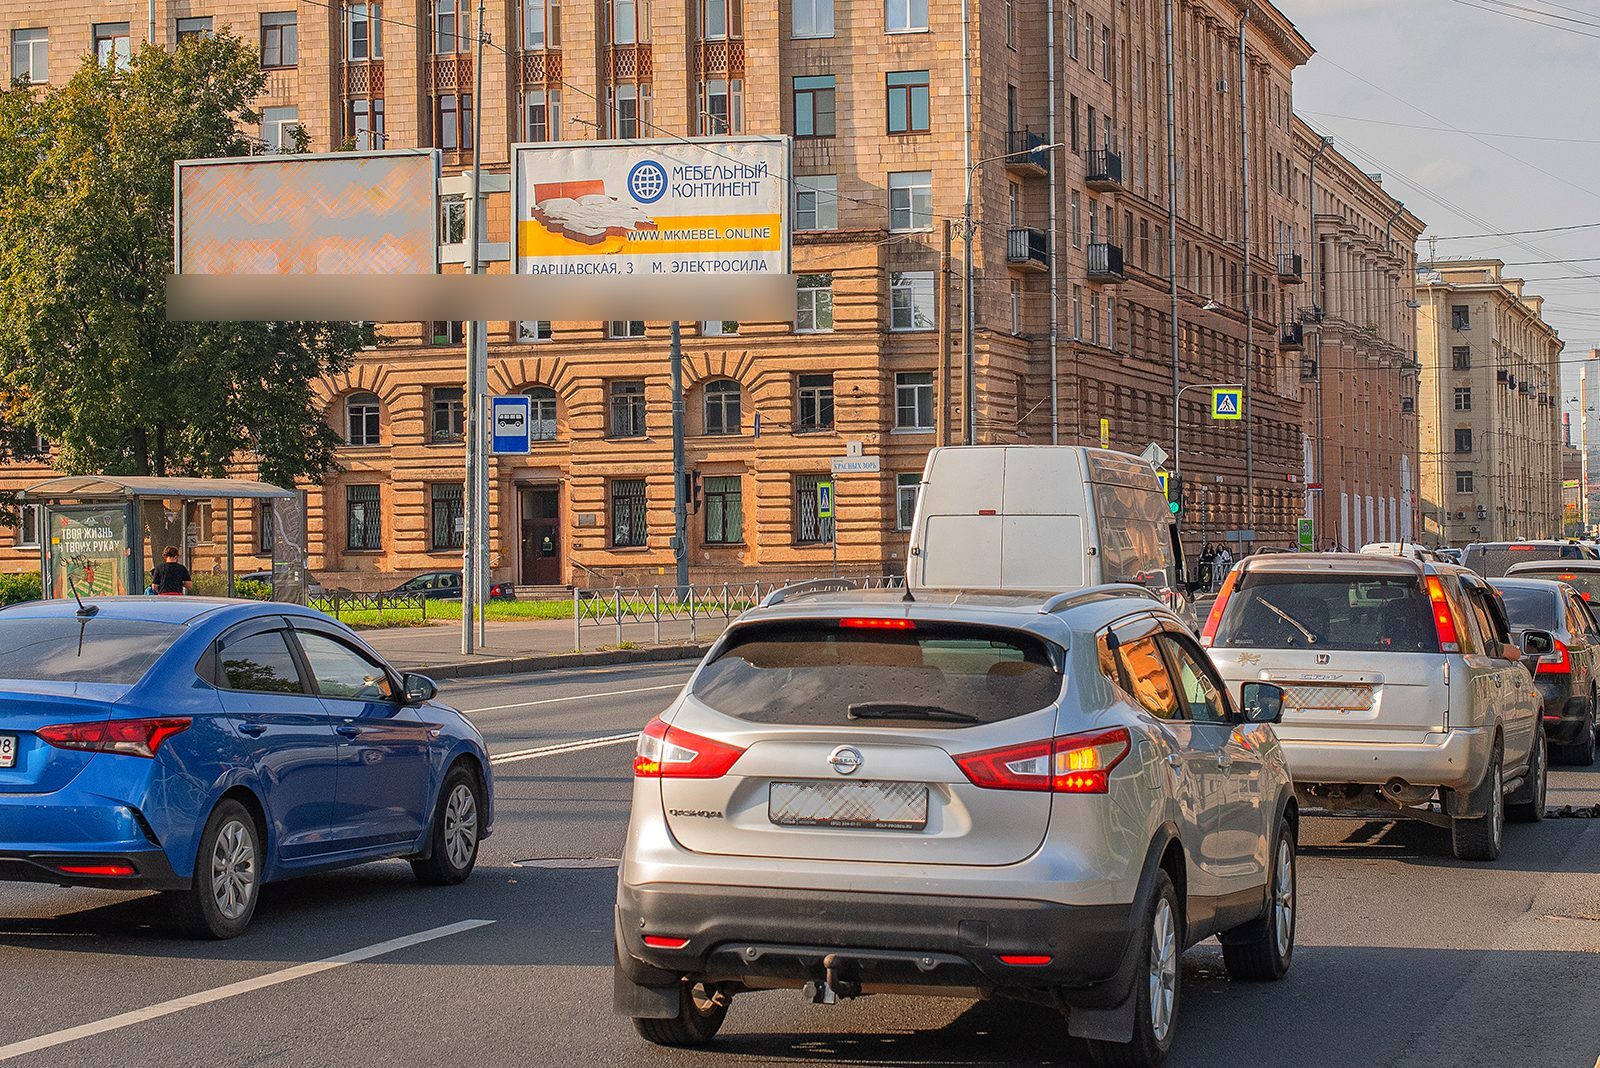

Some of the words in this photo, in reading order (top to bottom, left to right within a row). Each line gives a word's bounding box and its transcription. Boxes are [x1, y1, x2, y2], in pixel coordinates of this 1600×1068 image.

[672, 161, 768, 181] МЕБЕЛЬНЫЙ
[672, 181, 760, 198] КОНТИНЕНТ
[626, 228, 771, 241] WWW.MKMEBEL.ONLINE
[652, 261, 667, 273] М.
[671, 259, 768, 273] ЭЛЕКТРОСИЛА
[62, 528, 82, 540] ТВОЯ
[84, 527, 113, 539] ЖИЗНЬ
[65, 541, 92, 553] ТВОИХ
